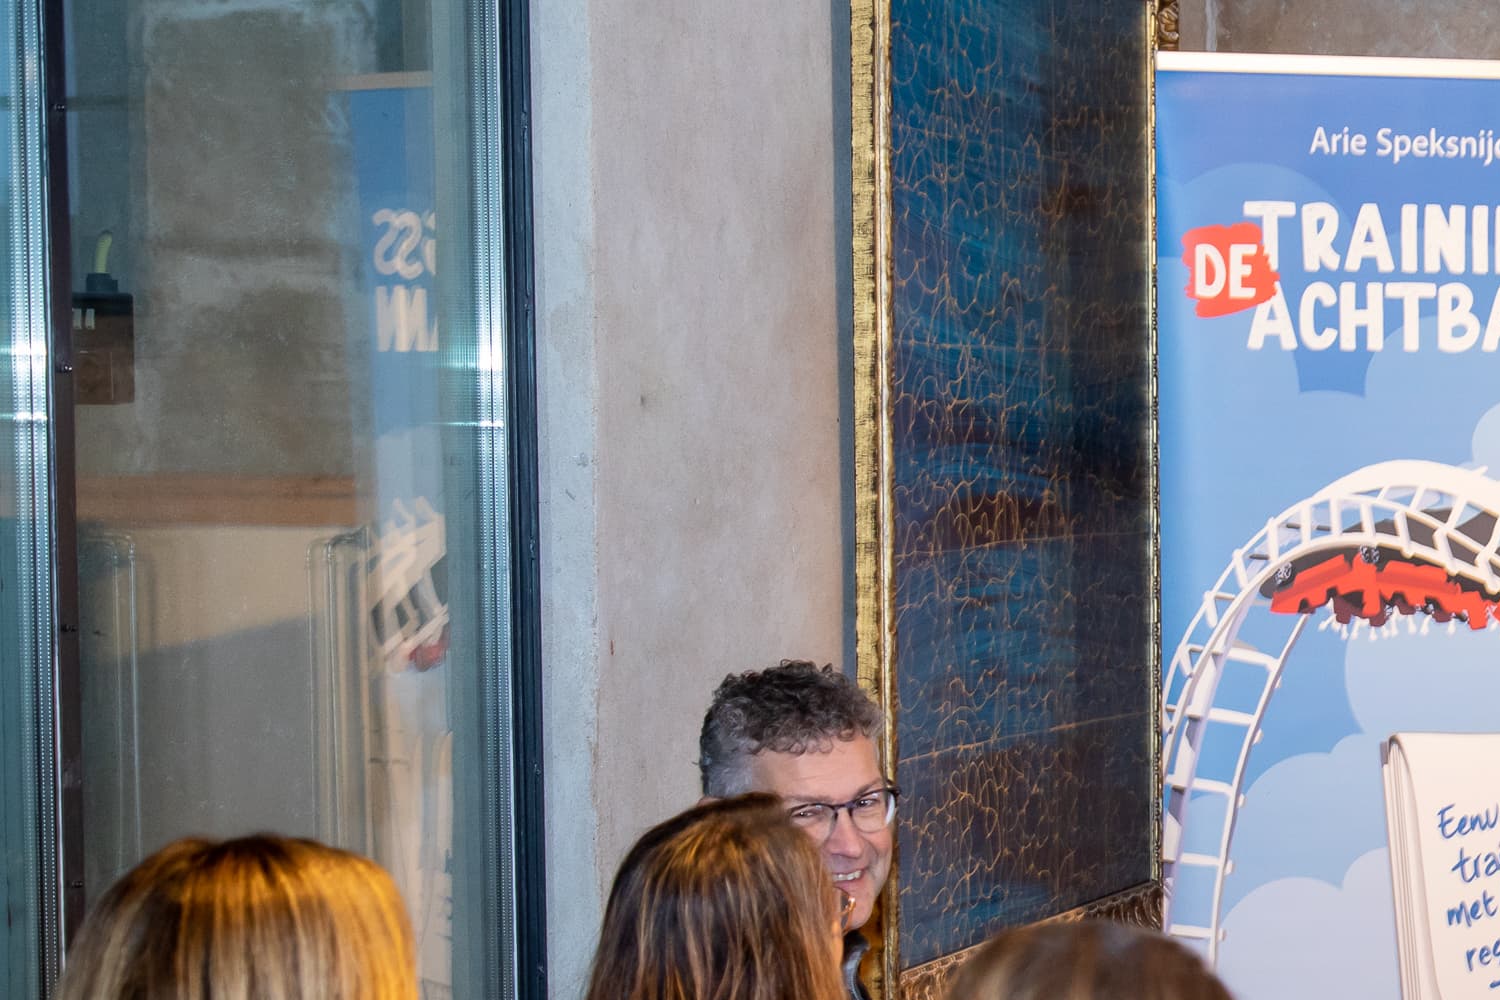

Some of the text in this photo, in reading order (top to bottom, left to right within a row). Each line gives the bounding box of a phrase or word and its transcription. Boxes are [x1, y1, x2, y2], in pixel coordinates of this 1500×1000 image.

[1309, 126, 1368, 156] Arie
[1194, 243, 1258, 299] DE
[1446, 890, 1497, 927] met
